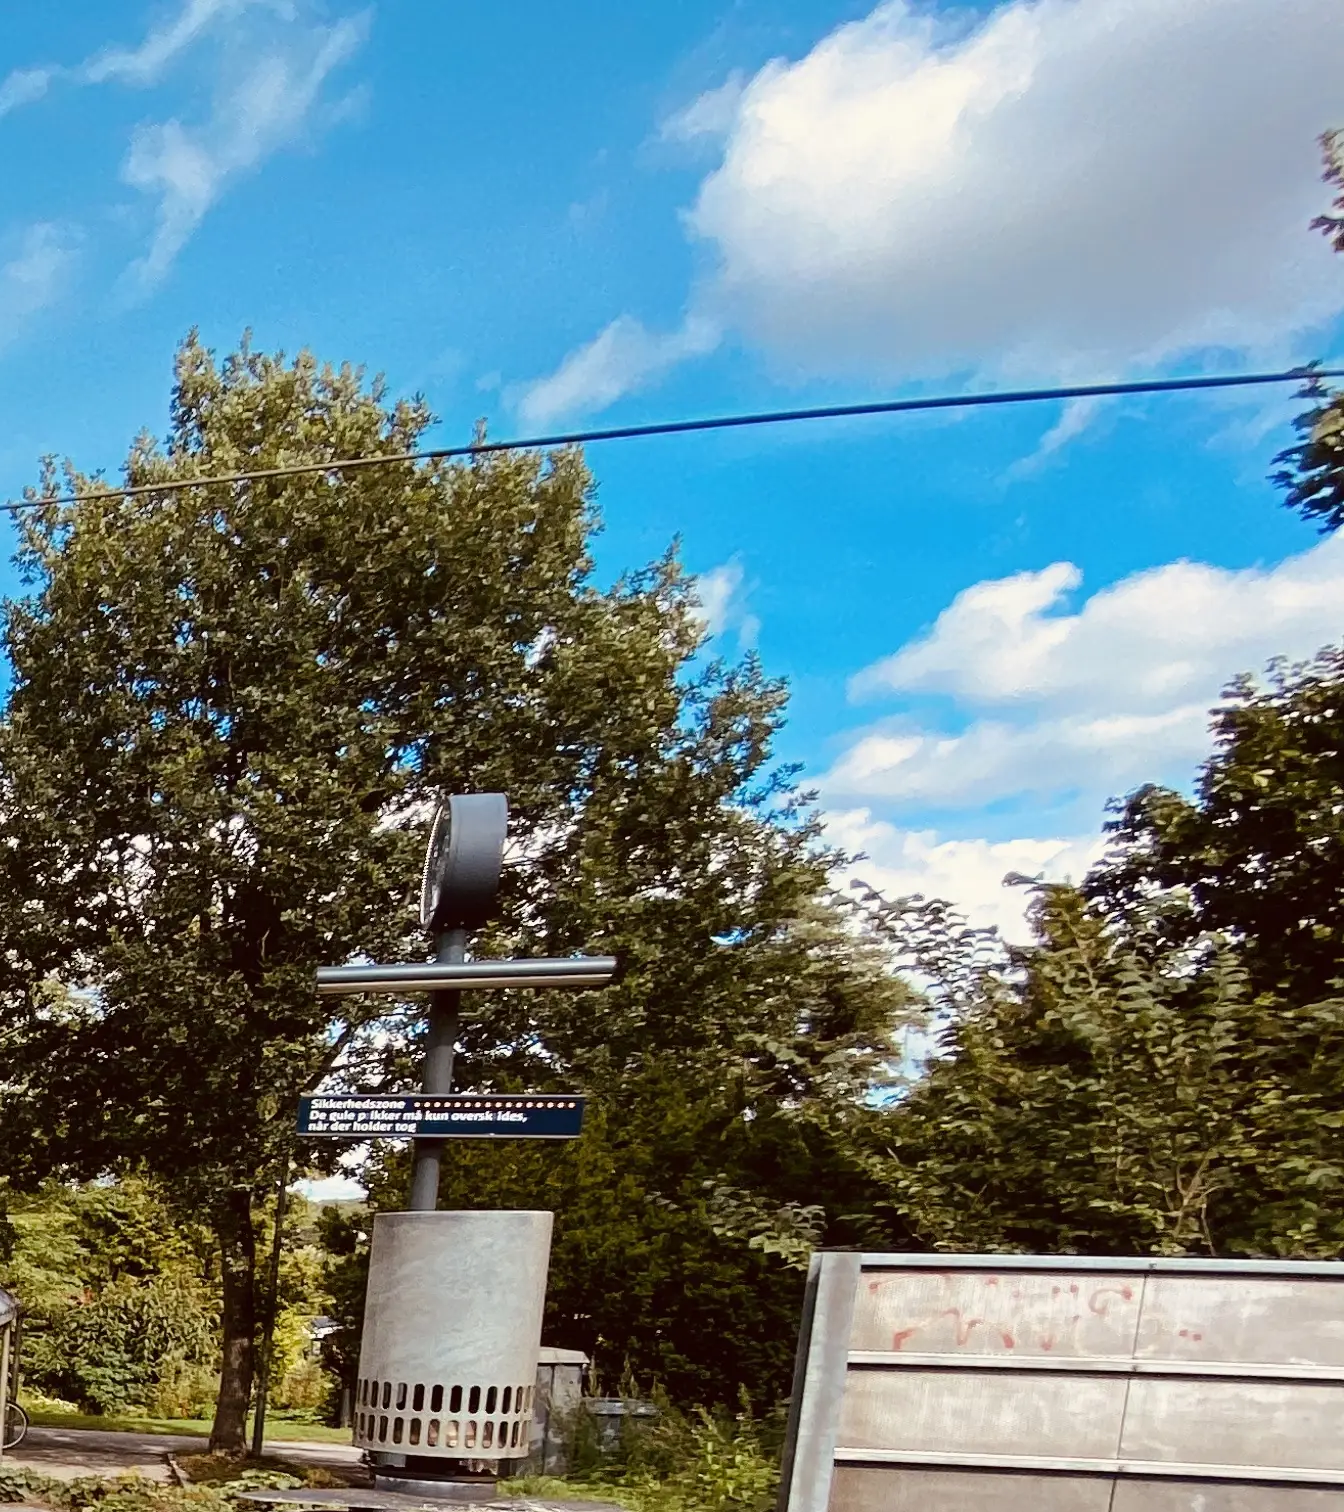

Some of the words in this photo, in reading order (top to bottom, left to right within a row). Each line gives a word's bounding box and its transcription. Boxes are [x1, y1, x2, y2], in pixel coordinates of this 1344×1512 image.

[310, 1098, 407, 1109] Sikkerhedszone
[309, 1110, 327, 1120] De
[329, 1110, 355, 1121] gule
[357, 1110, 402, 1121] pikker
[403, 1110, 423, 1121] må
[425, 1110, 449, 1121] kun
[308, 1121, 329, 1131] når
[330, 1121, 352, 1131] der
[352, 1121, 393, 1131] holder
[395, 1121, 417, 1133] tog
